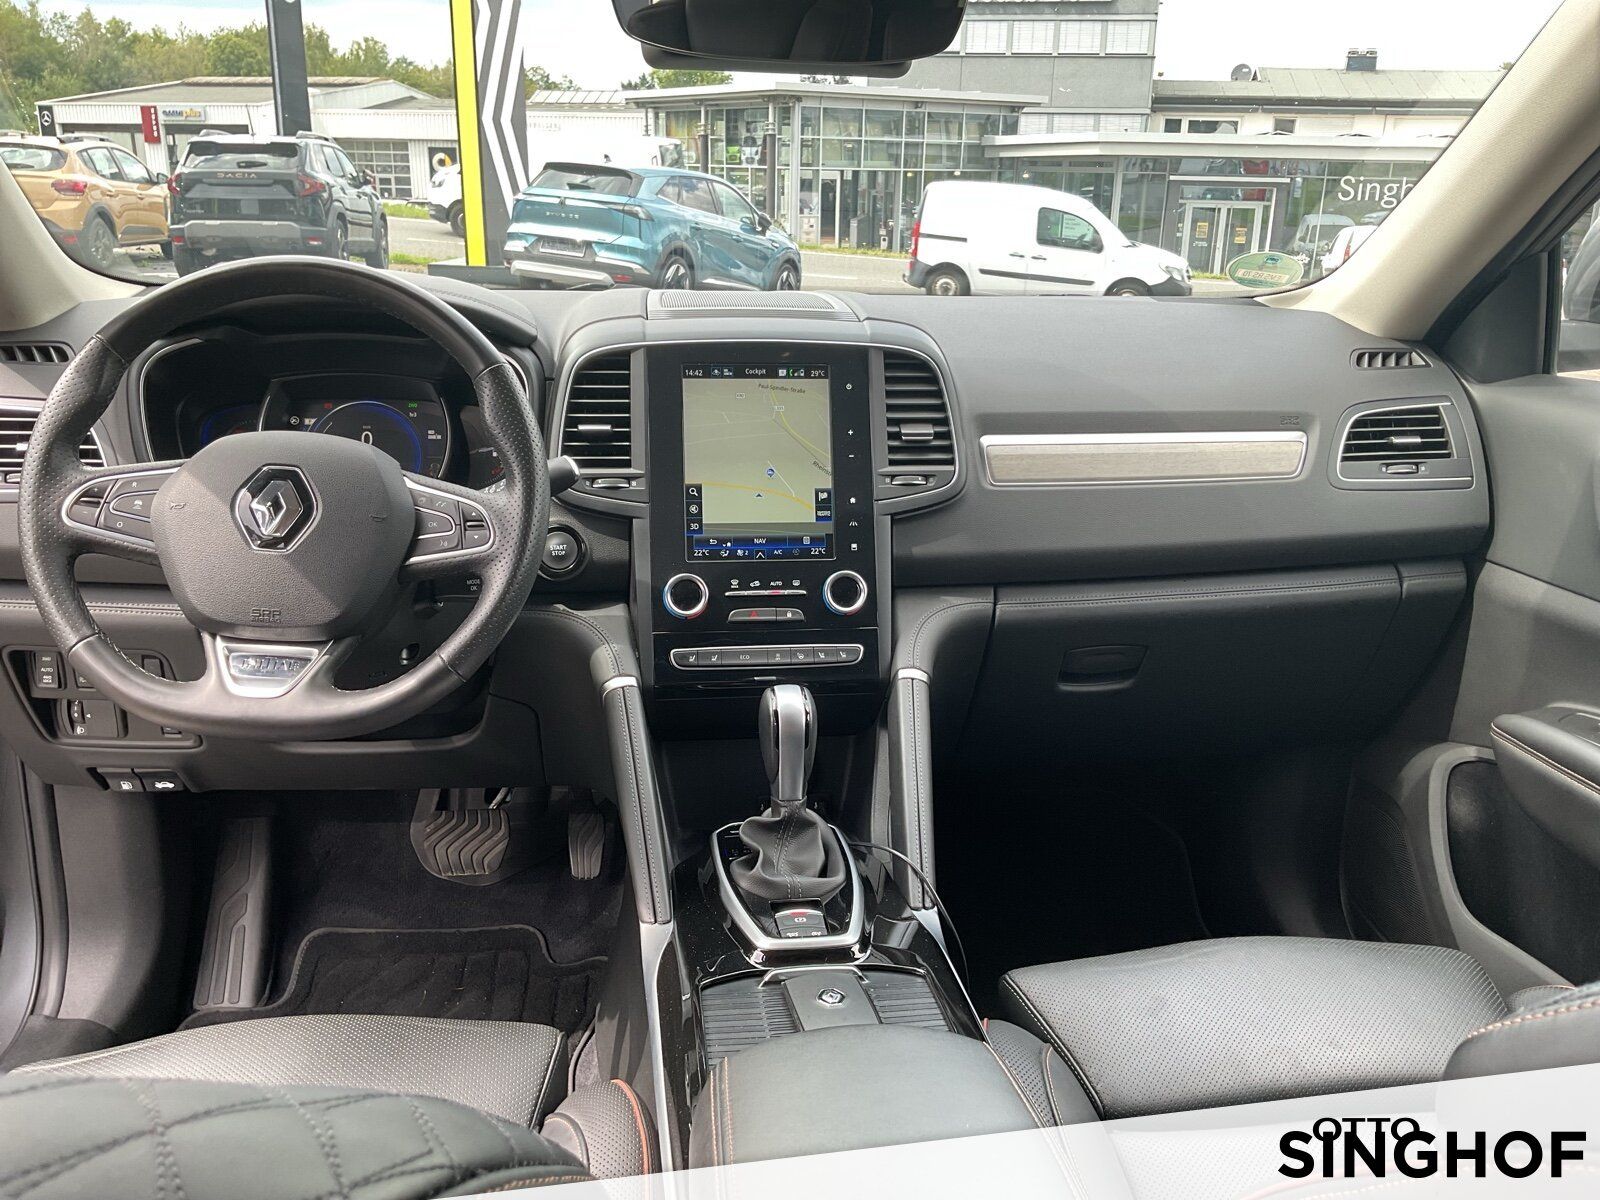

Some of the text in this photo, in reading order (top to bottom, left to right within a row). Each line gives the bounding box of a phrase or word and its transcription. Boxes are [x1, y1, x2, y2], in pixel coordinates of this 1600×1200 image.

[685, 369, 703, 377] 14:42
[745, 368, 766, 376] Cockpit
[693, 549, 709, 557] 22°C
[810, 547, 826, 555] 22°C
